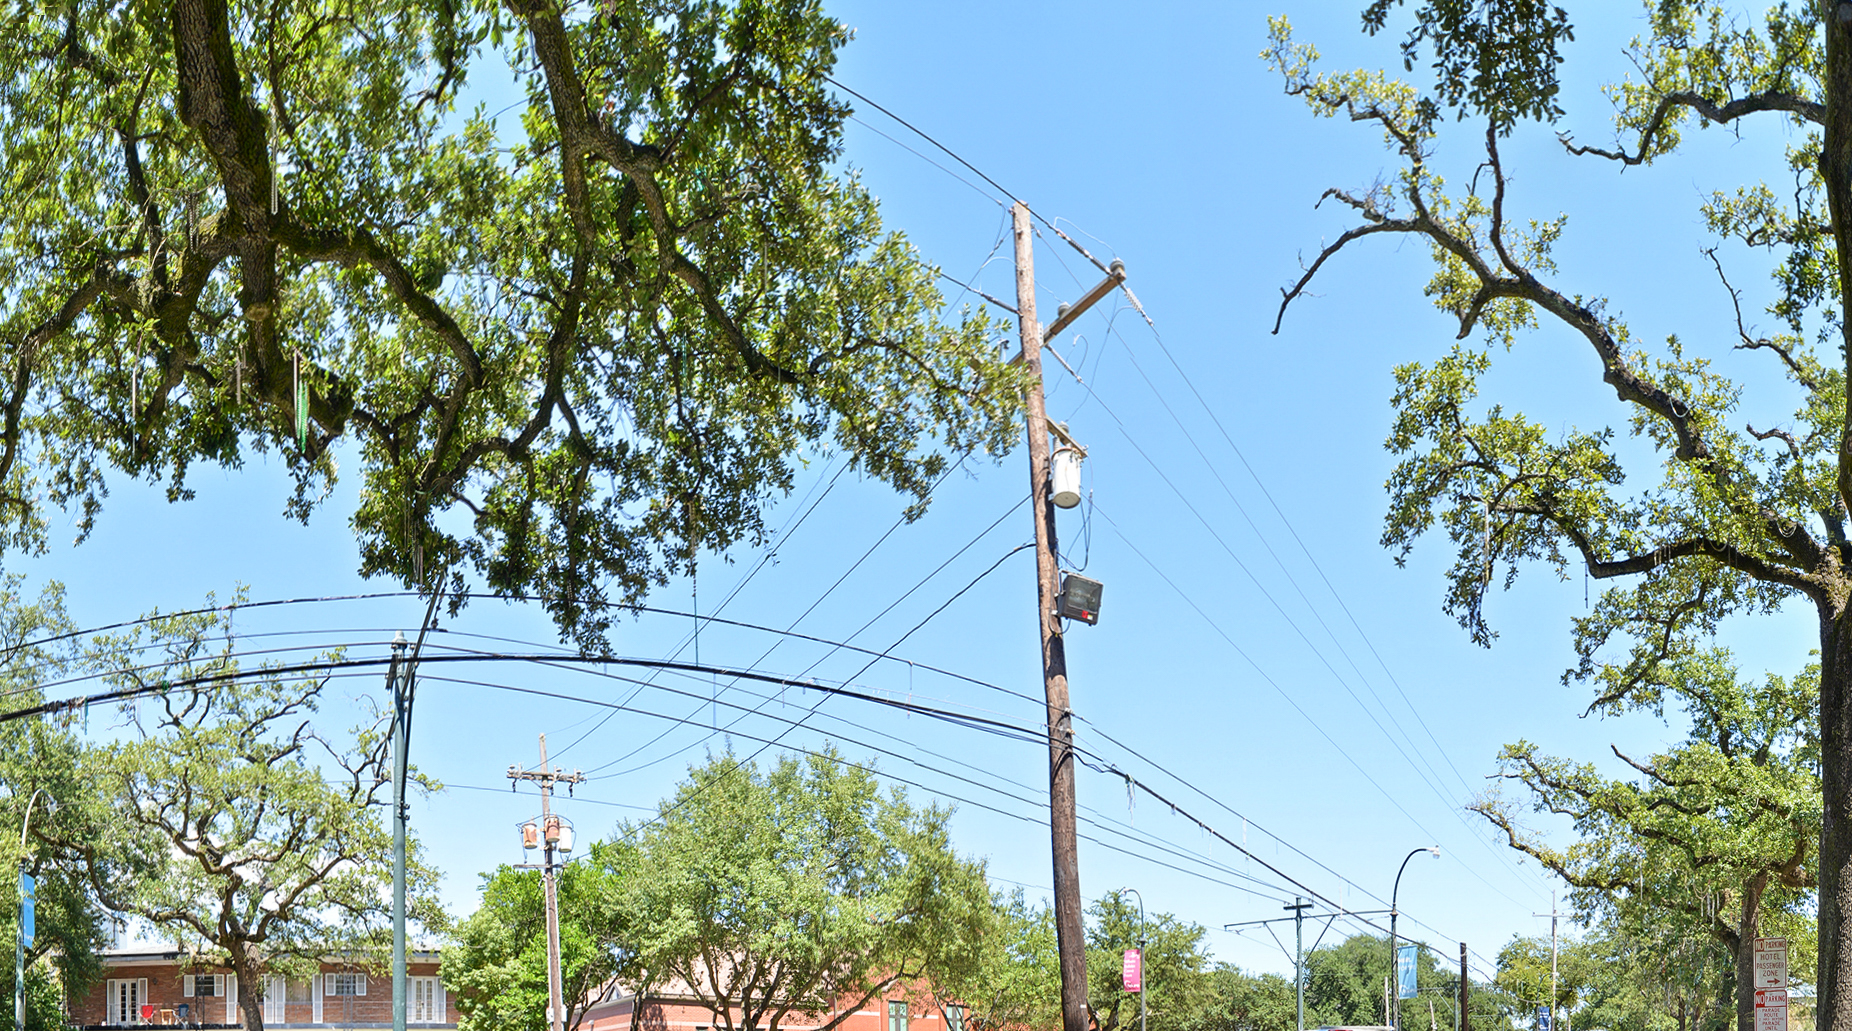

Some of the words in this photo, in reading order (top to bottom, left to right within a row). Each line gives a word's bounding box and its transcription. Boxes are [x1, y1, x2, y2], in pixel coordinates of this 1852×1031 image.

[1756, 940, 1764, 950] NO
[1765, 940, 1785, 949] PARKING
[1756, 994, 1765, 1005] NO
[1765, 995, 1786, 1003] PARKING
